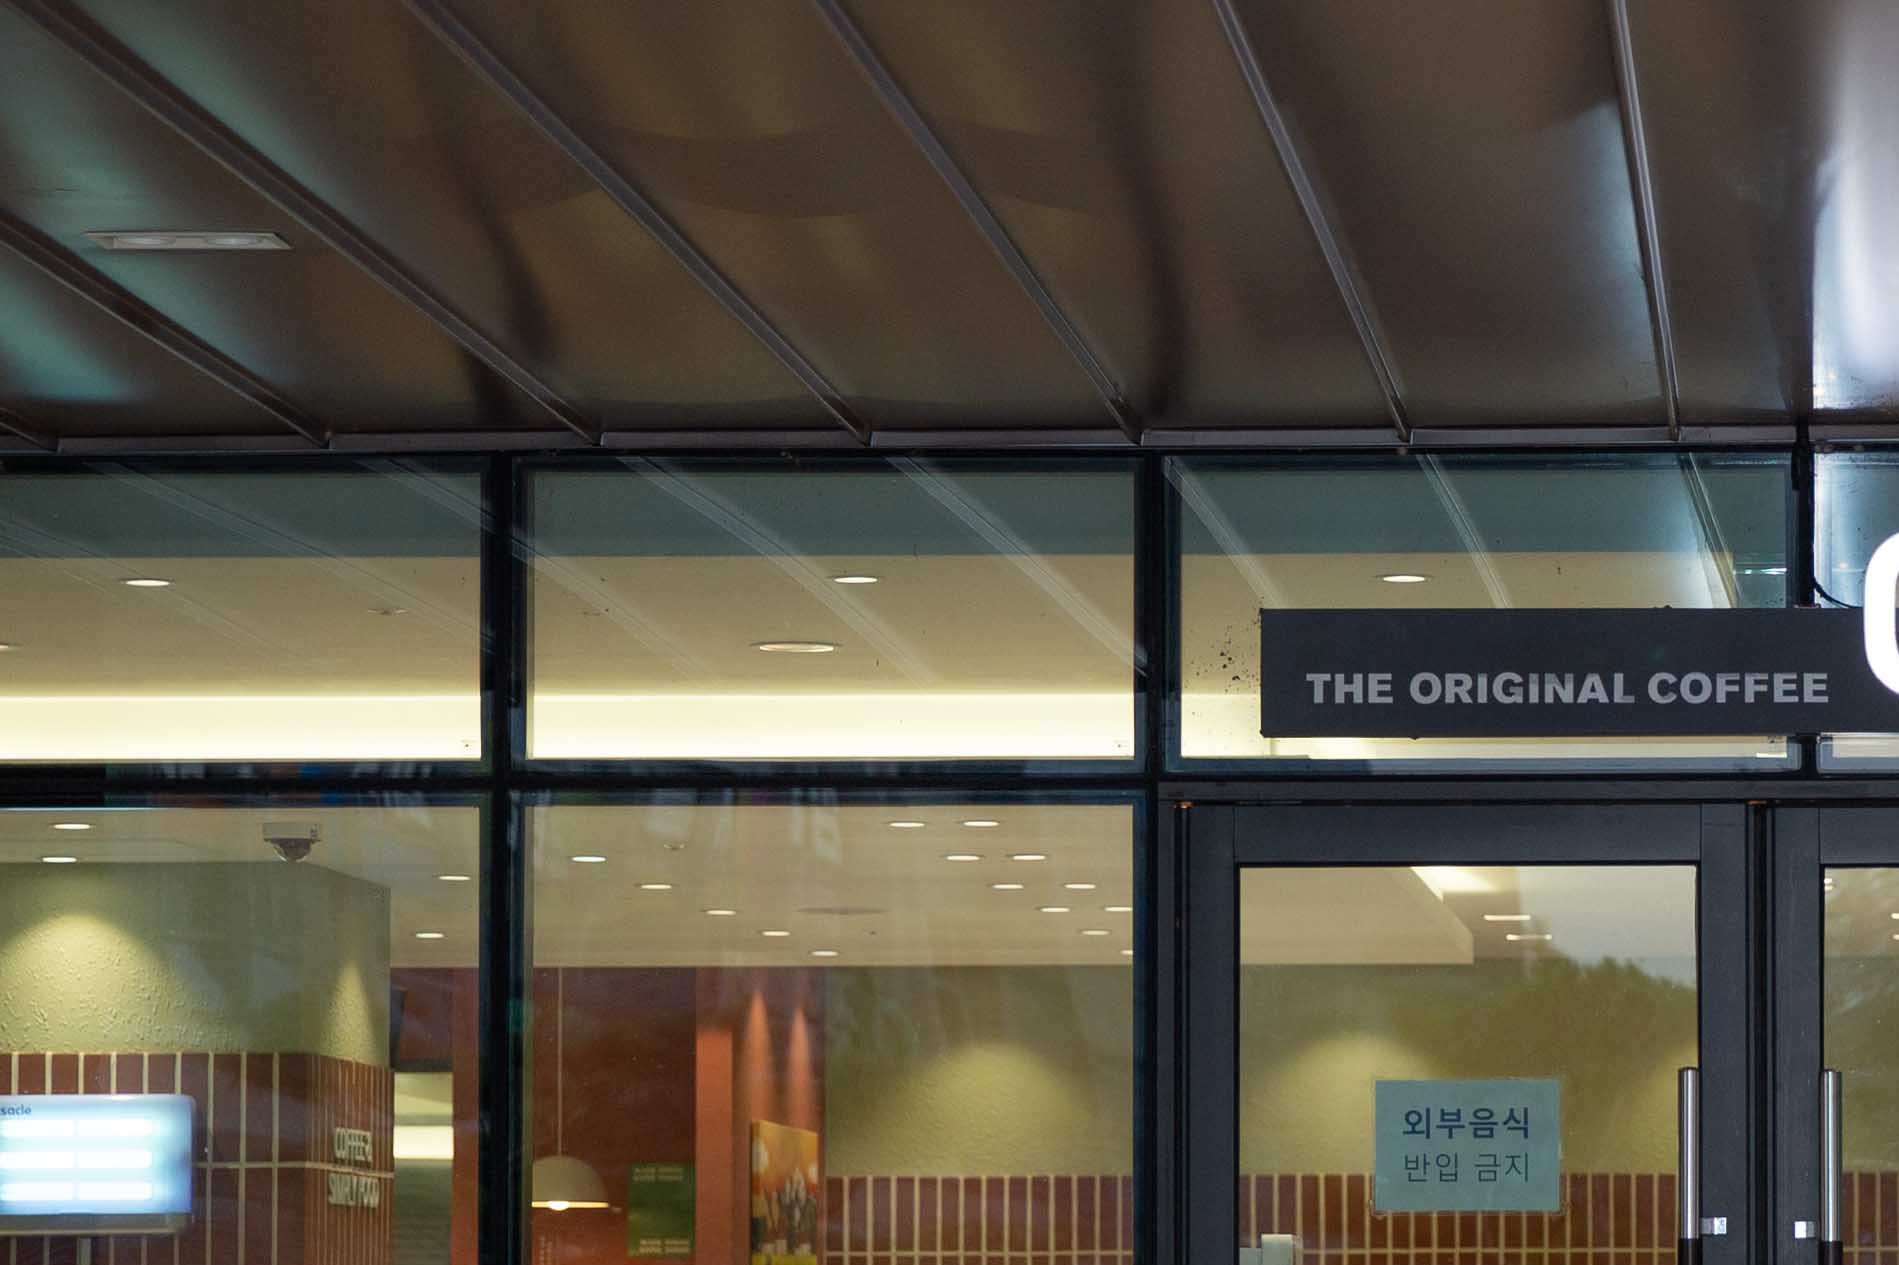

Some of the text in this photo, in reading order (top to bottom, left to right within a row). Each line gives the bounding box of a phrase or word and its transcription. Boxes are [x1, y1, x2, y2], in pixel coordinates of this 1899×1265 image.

[1306, 671, 1829, 705] THE ORIGINAL COFFEE
[1402, 1107, 1530, 1140] 외부음식
[1403, 1152, 1530, 1183] 반입 금지
